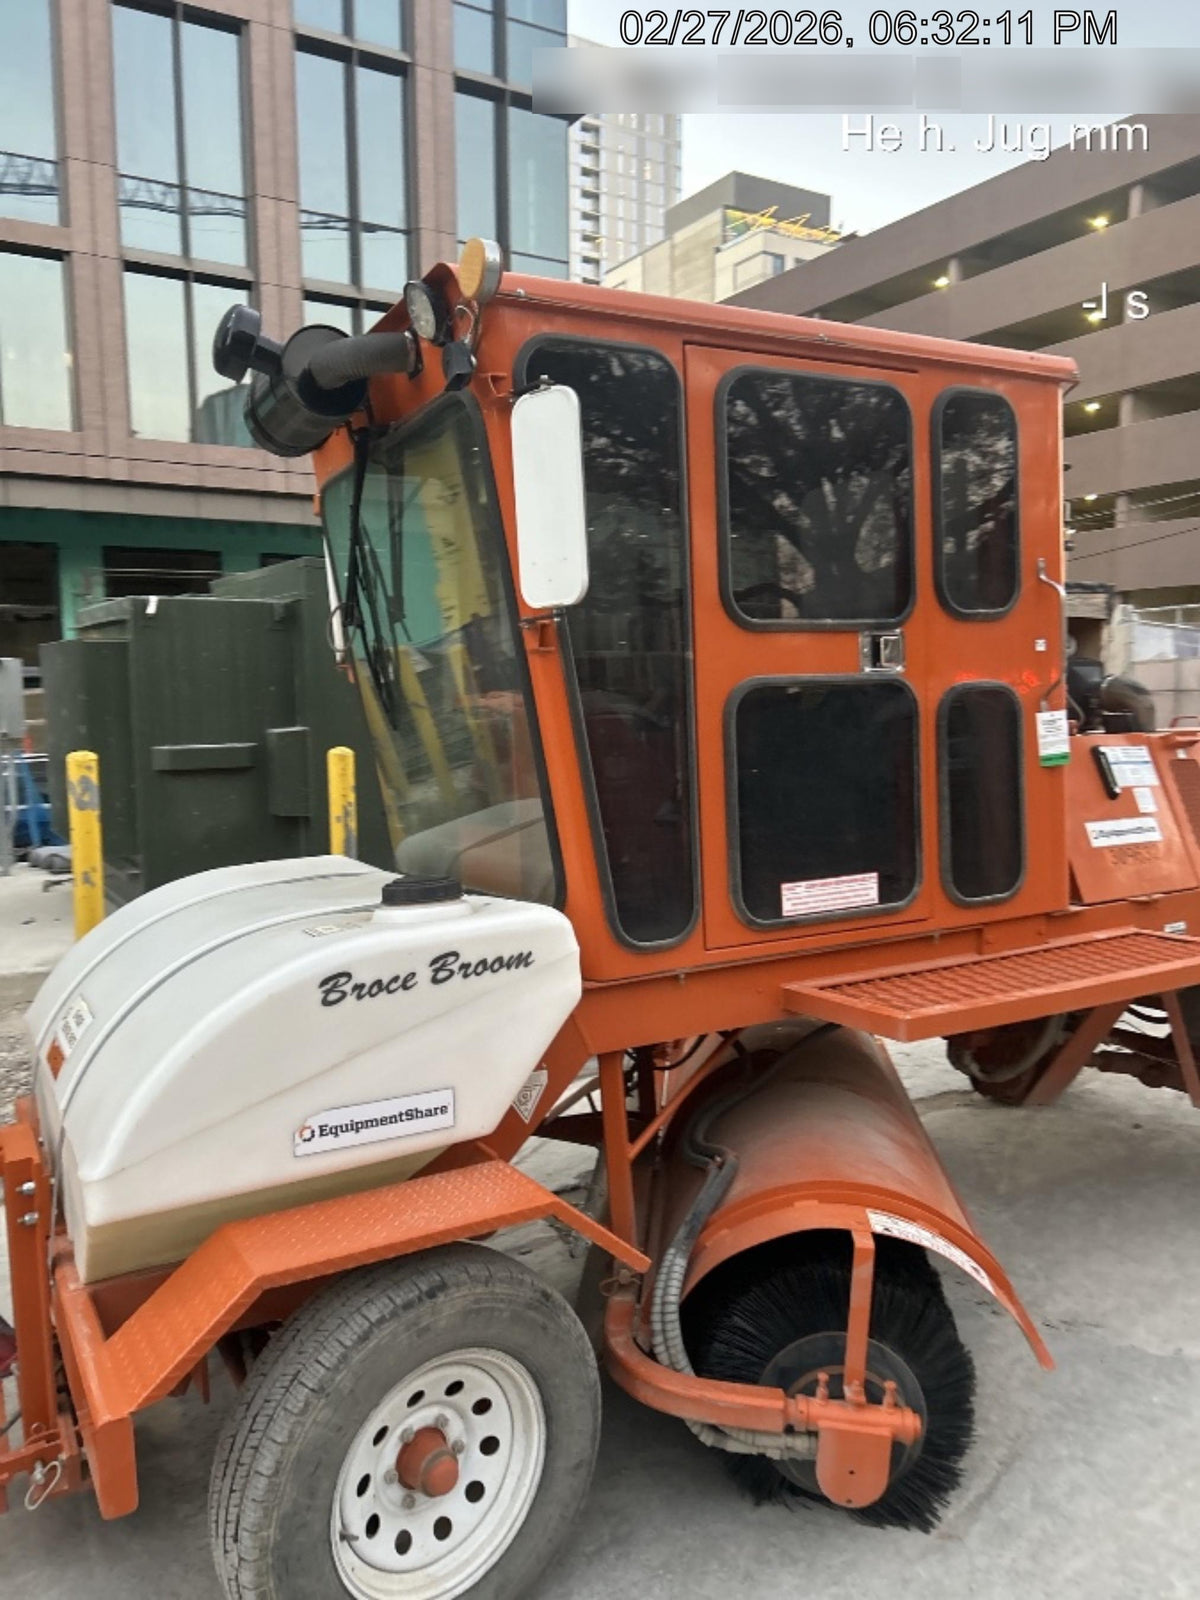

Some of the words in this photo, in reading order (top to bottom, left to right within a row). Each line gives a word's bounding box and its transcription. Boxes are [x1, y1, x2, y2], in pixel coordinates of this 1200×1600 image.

[318, 971, 418, 1007] Broce
[428, 951, 535, 985] Broom
[317, 1103, 449, 1138] EquipmentShare
